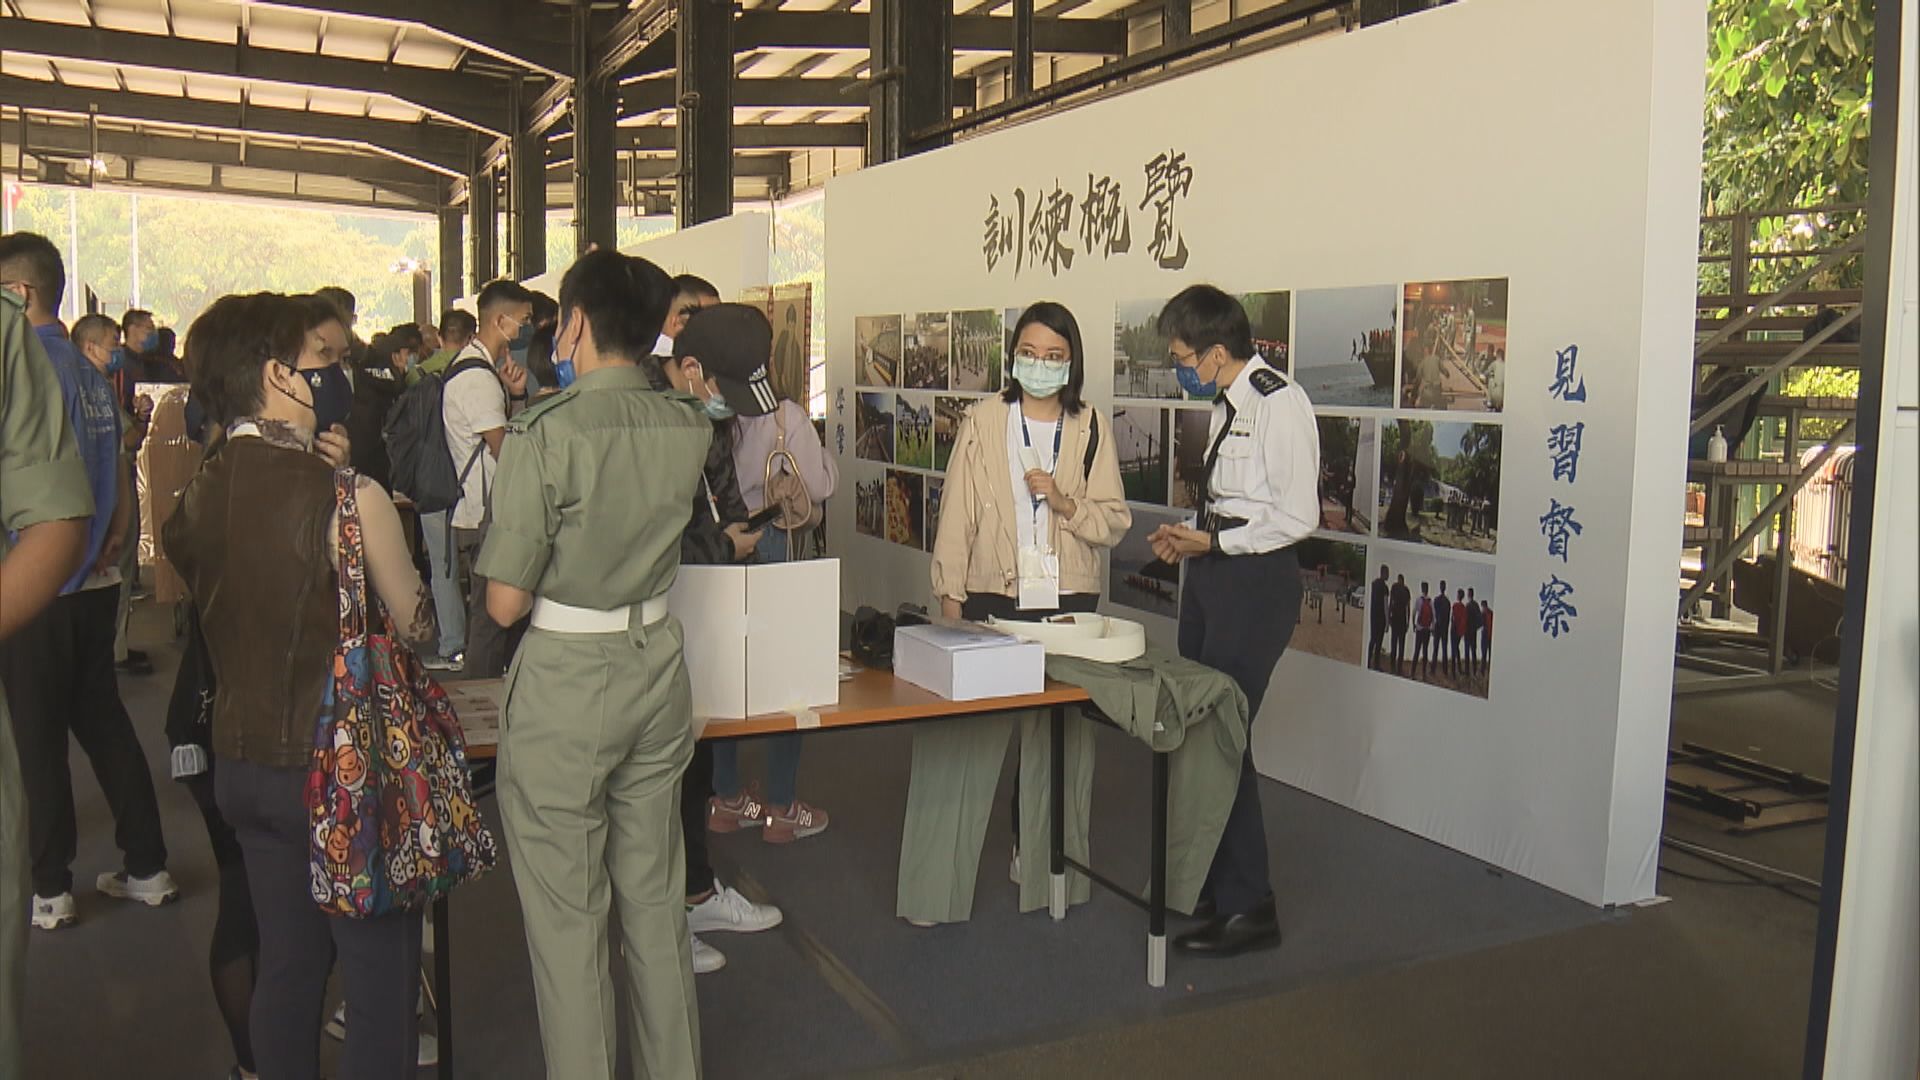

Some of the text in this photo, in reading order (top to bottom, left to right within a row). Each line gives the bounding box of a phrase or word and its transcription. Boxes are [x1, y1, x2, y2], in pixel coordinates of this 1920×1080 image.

[983, 148, 1193, 280] 訓練概覽
[1539, 344, 1587, 639] 見習督察
[744, 802, 761, 819] N
[799, 810, 812, 827] N
